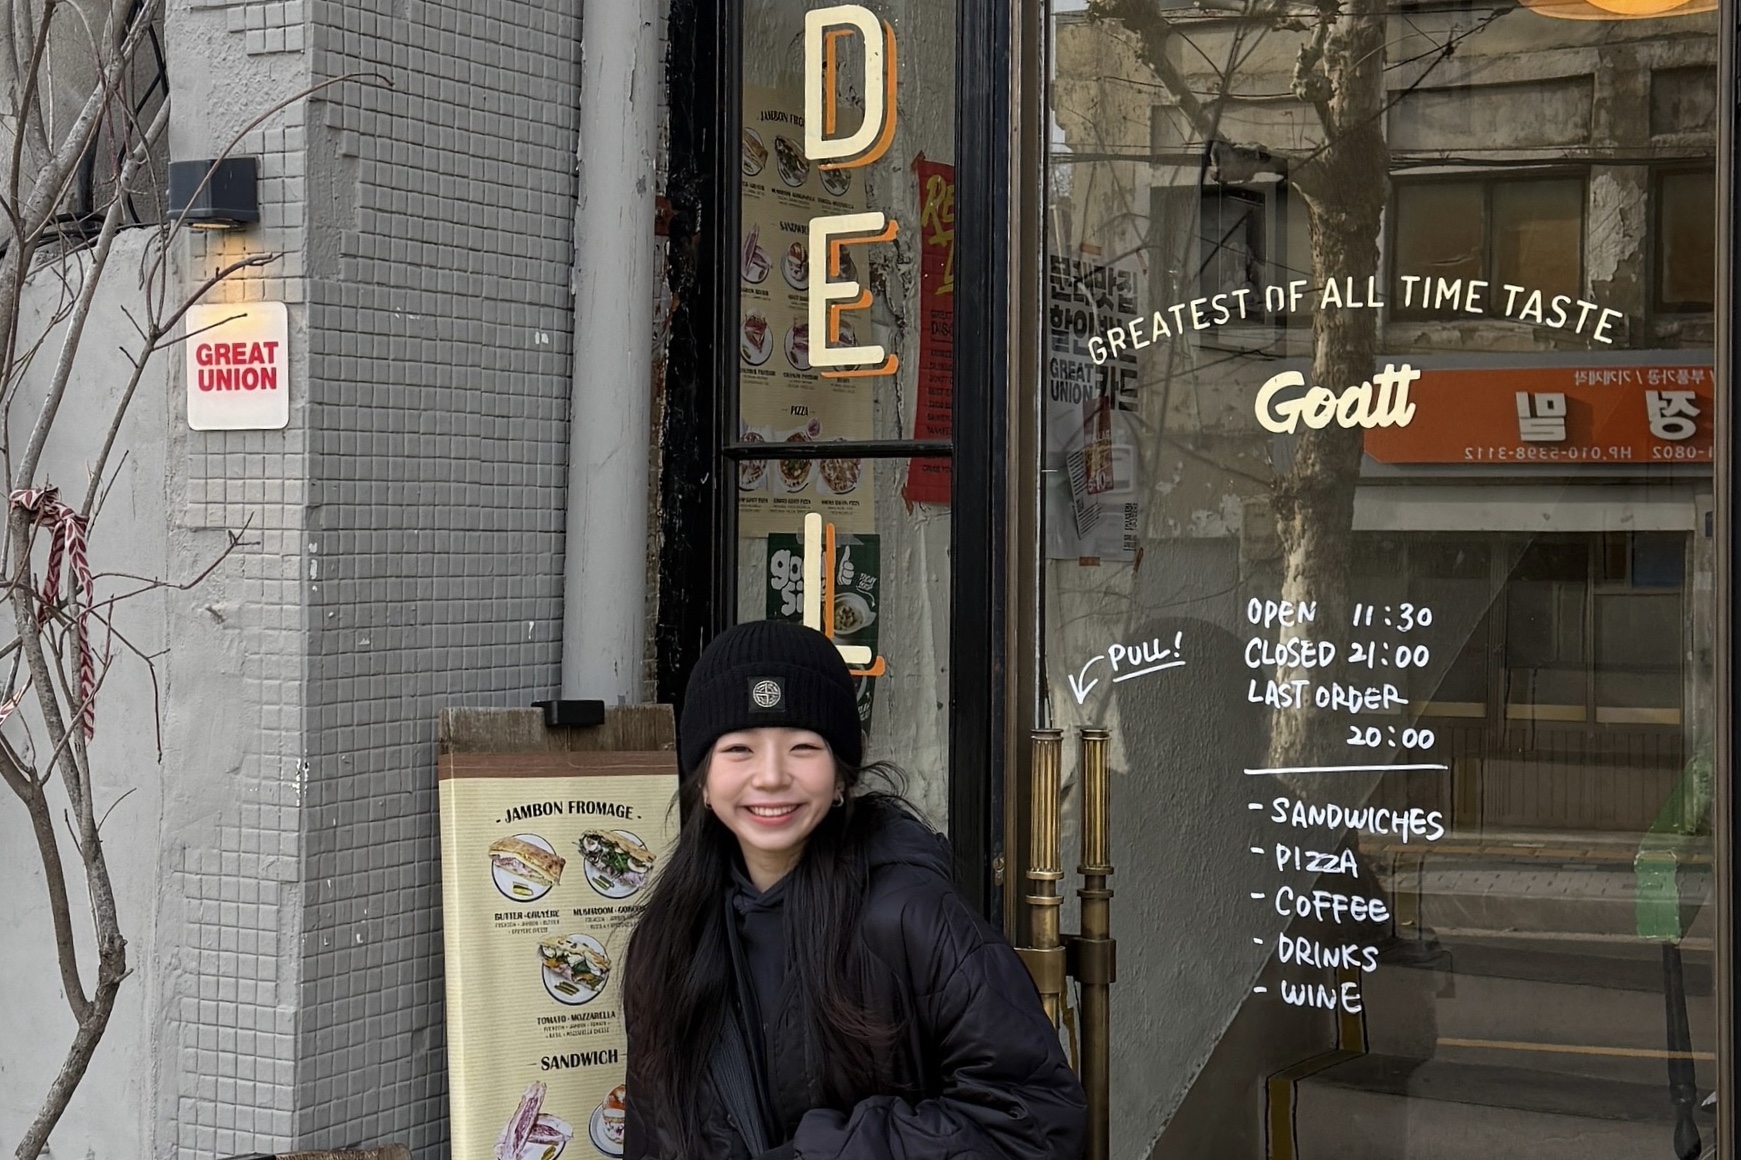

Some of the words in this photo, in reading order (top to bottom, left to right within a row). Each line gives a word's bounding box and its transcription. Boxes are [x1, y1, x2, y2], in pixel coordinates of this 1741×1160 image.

[1087, 288, 1250, 365] GREATEST
[1265, 280, 1308, 313] OF
[1320, 275, 1384, 310] ALL
[1401, 275, 1489, 313] TIME
[1503, 284, 1623, 344] TASTE
[196, 341, 279, 366] GREAT
[198, 367, 277, 392] UNION
[1050, 357, 1094, 384] GREAT
[1050, 380, 1093, 405] UNION
[1255, 362, 1422, 436] Goatt
[791, 404, 809, 416] PIZZA
[1248, 597, 1317, 628] OPEN
[1352, 602, 1433, 632] 11:30
[1107, 631, 1184, 671] PULL!
[1245, 637, 1336, 668] CLOSED
[1348, 641, 1430, 669] 21:00
[1248, 679, 1310, 709] LAST
[1316, 682, 1409, 714] ORDER
[1346, 725, 1435, 749] 20:00
[505, 801, 563, 823] JAMBON
[568, 800, 634, 820] FROMAGE
[1271, 797, 1444, 844] SANDWICHES
[1275, 842, 1359, 878] PIZZA
[1275, 885, 1390, 924] COFFEE
[1278, 932, 1379, 972] DRINKS
[1281, 980, 1362, 1014] WINE
[537, 1015, 566, 1025] TOMATO
[571, 1010, 616, 1021] MOZZARELLA
[540, 1049, 619, 1072] SANDWICH
